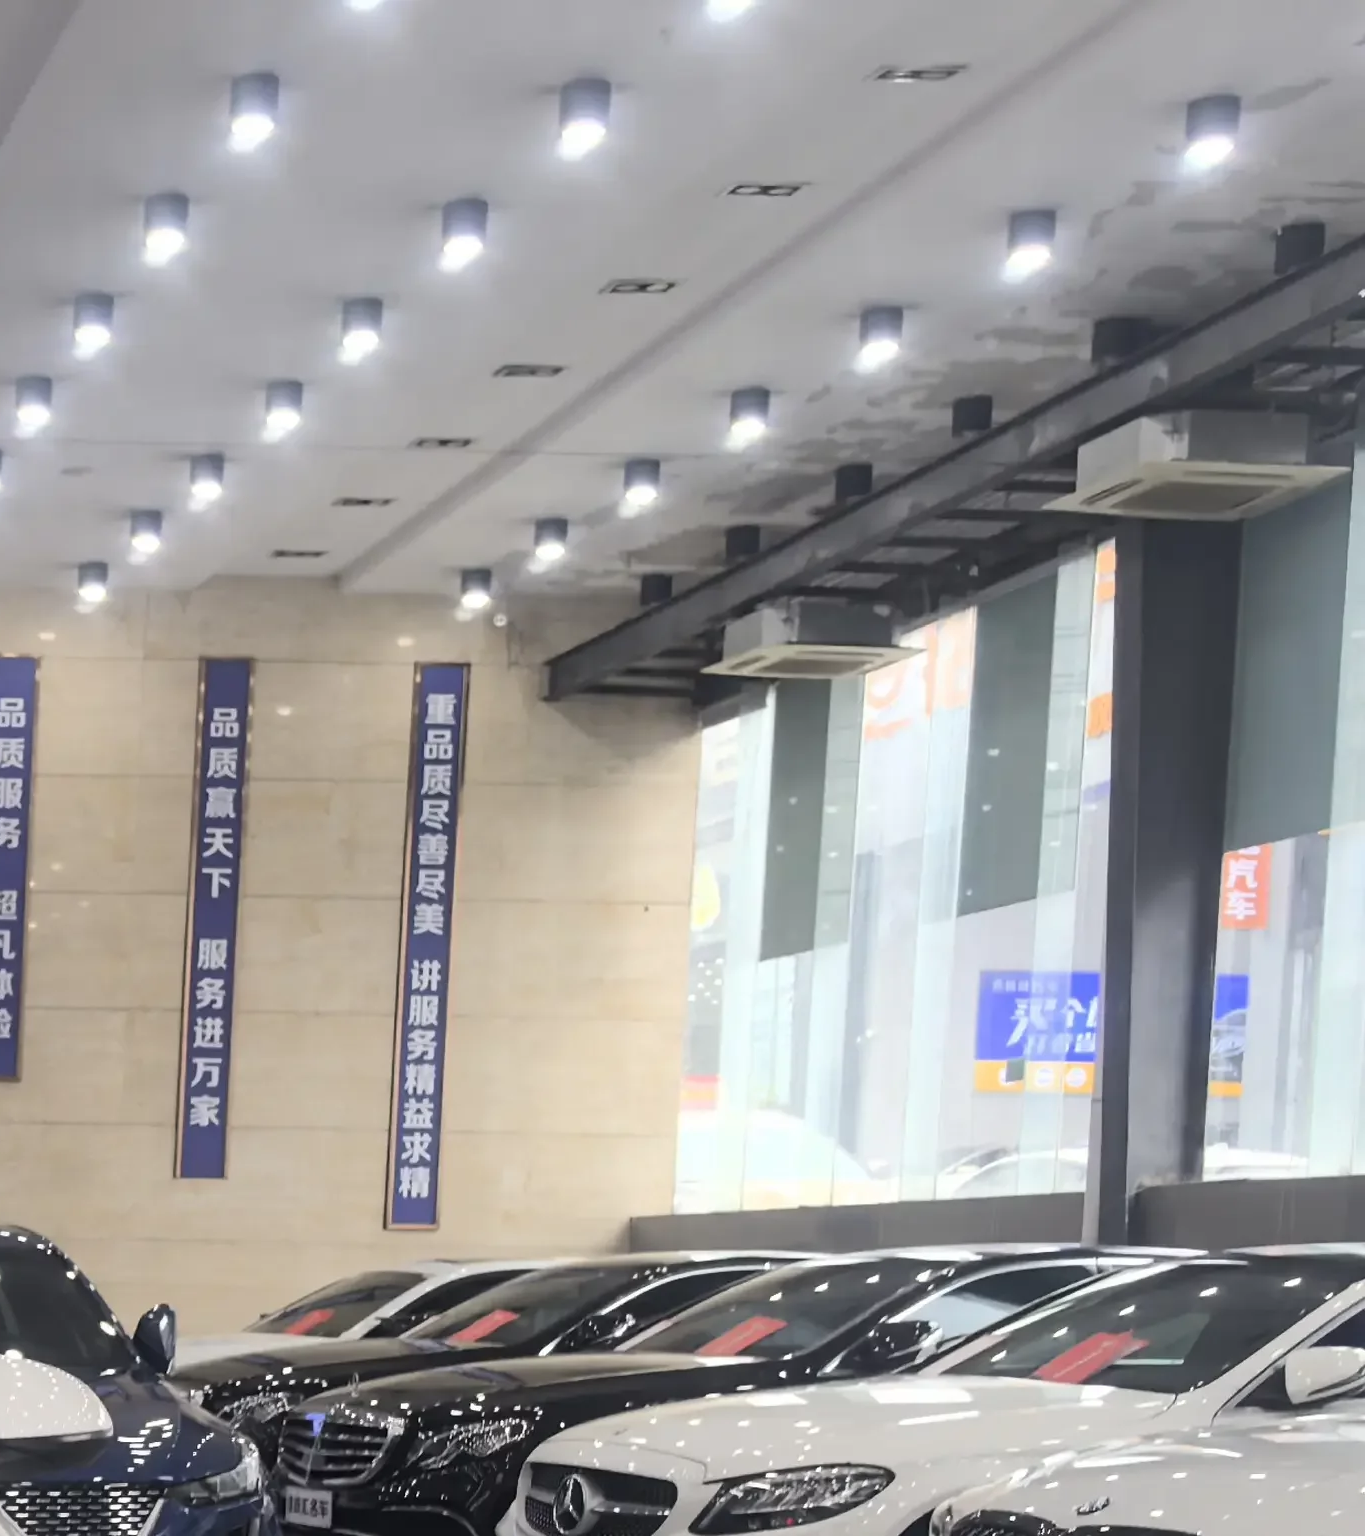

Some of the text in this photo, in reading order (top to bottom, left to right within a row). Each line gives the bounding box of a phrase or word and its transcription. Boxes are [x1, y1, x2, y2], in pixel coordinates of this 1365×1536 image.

[189, 707, 241, 1128] 品质赢天下 服务进万家
[398, 693, 456, 1199] 重品质尽善尽美 讲服务精益求精
[1226, 845, 1261, 920] 汽车
